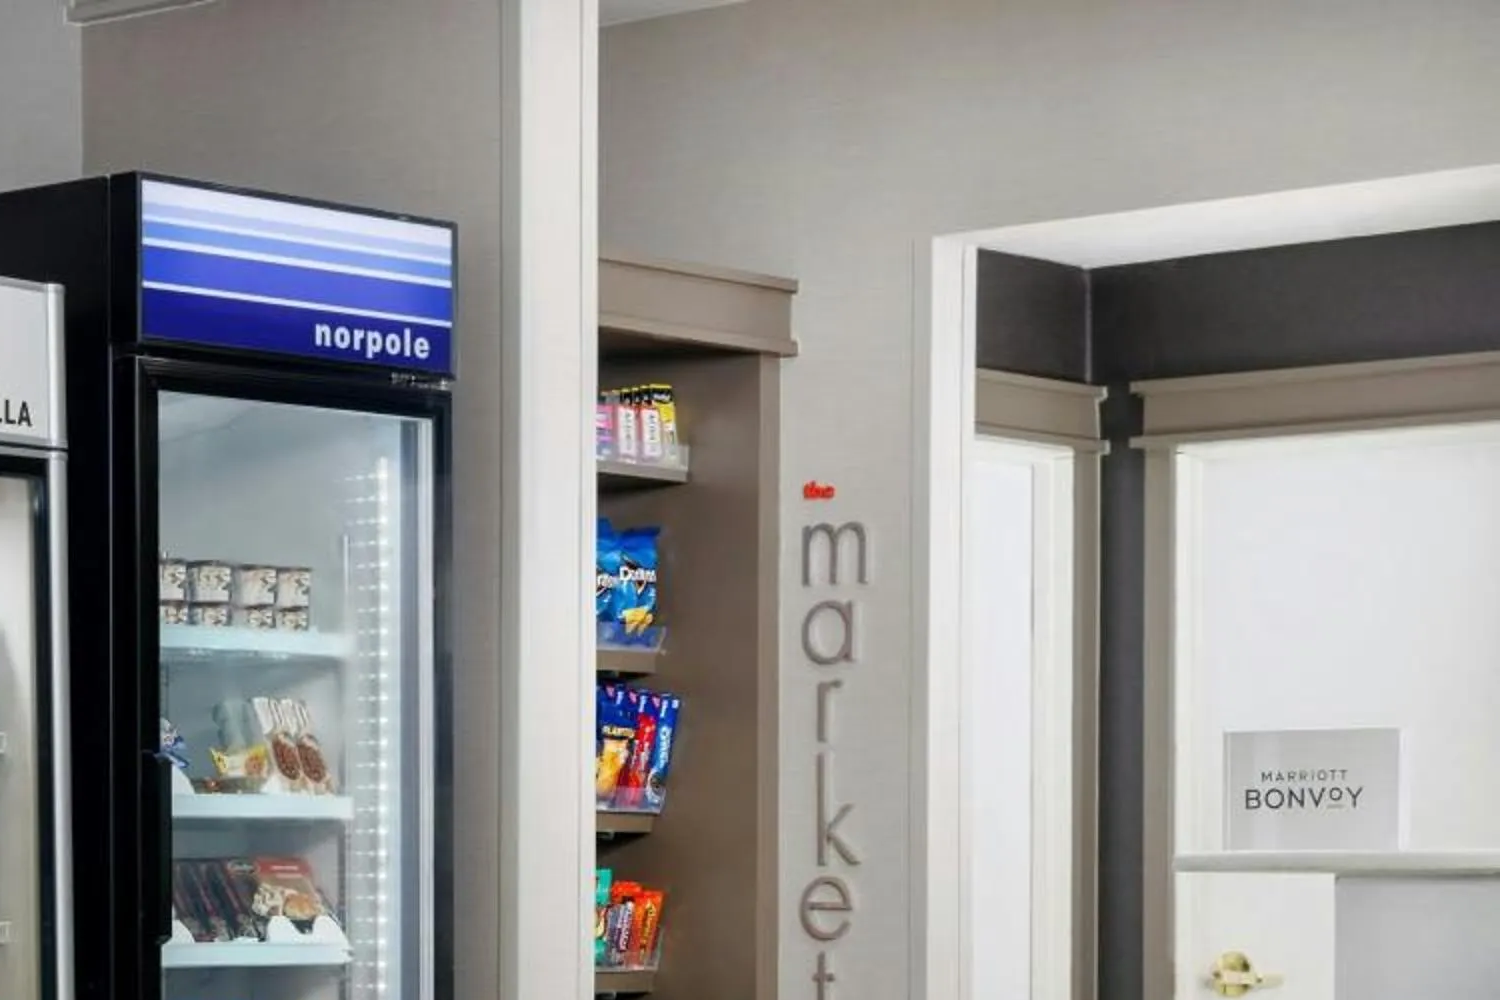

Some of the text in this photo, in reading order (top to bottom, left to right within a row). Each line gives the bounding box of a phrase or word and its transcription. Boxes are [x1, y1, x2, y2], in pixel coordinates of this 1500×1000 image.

[315, 323, 430, 359] norpole
[1261, 769, 1348, 783] MARRIOTT
[1245, 786, 1363, 810] BONVOY
